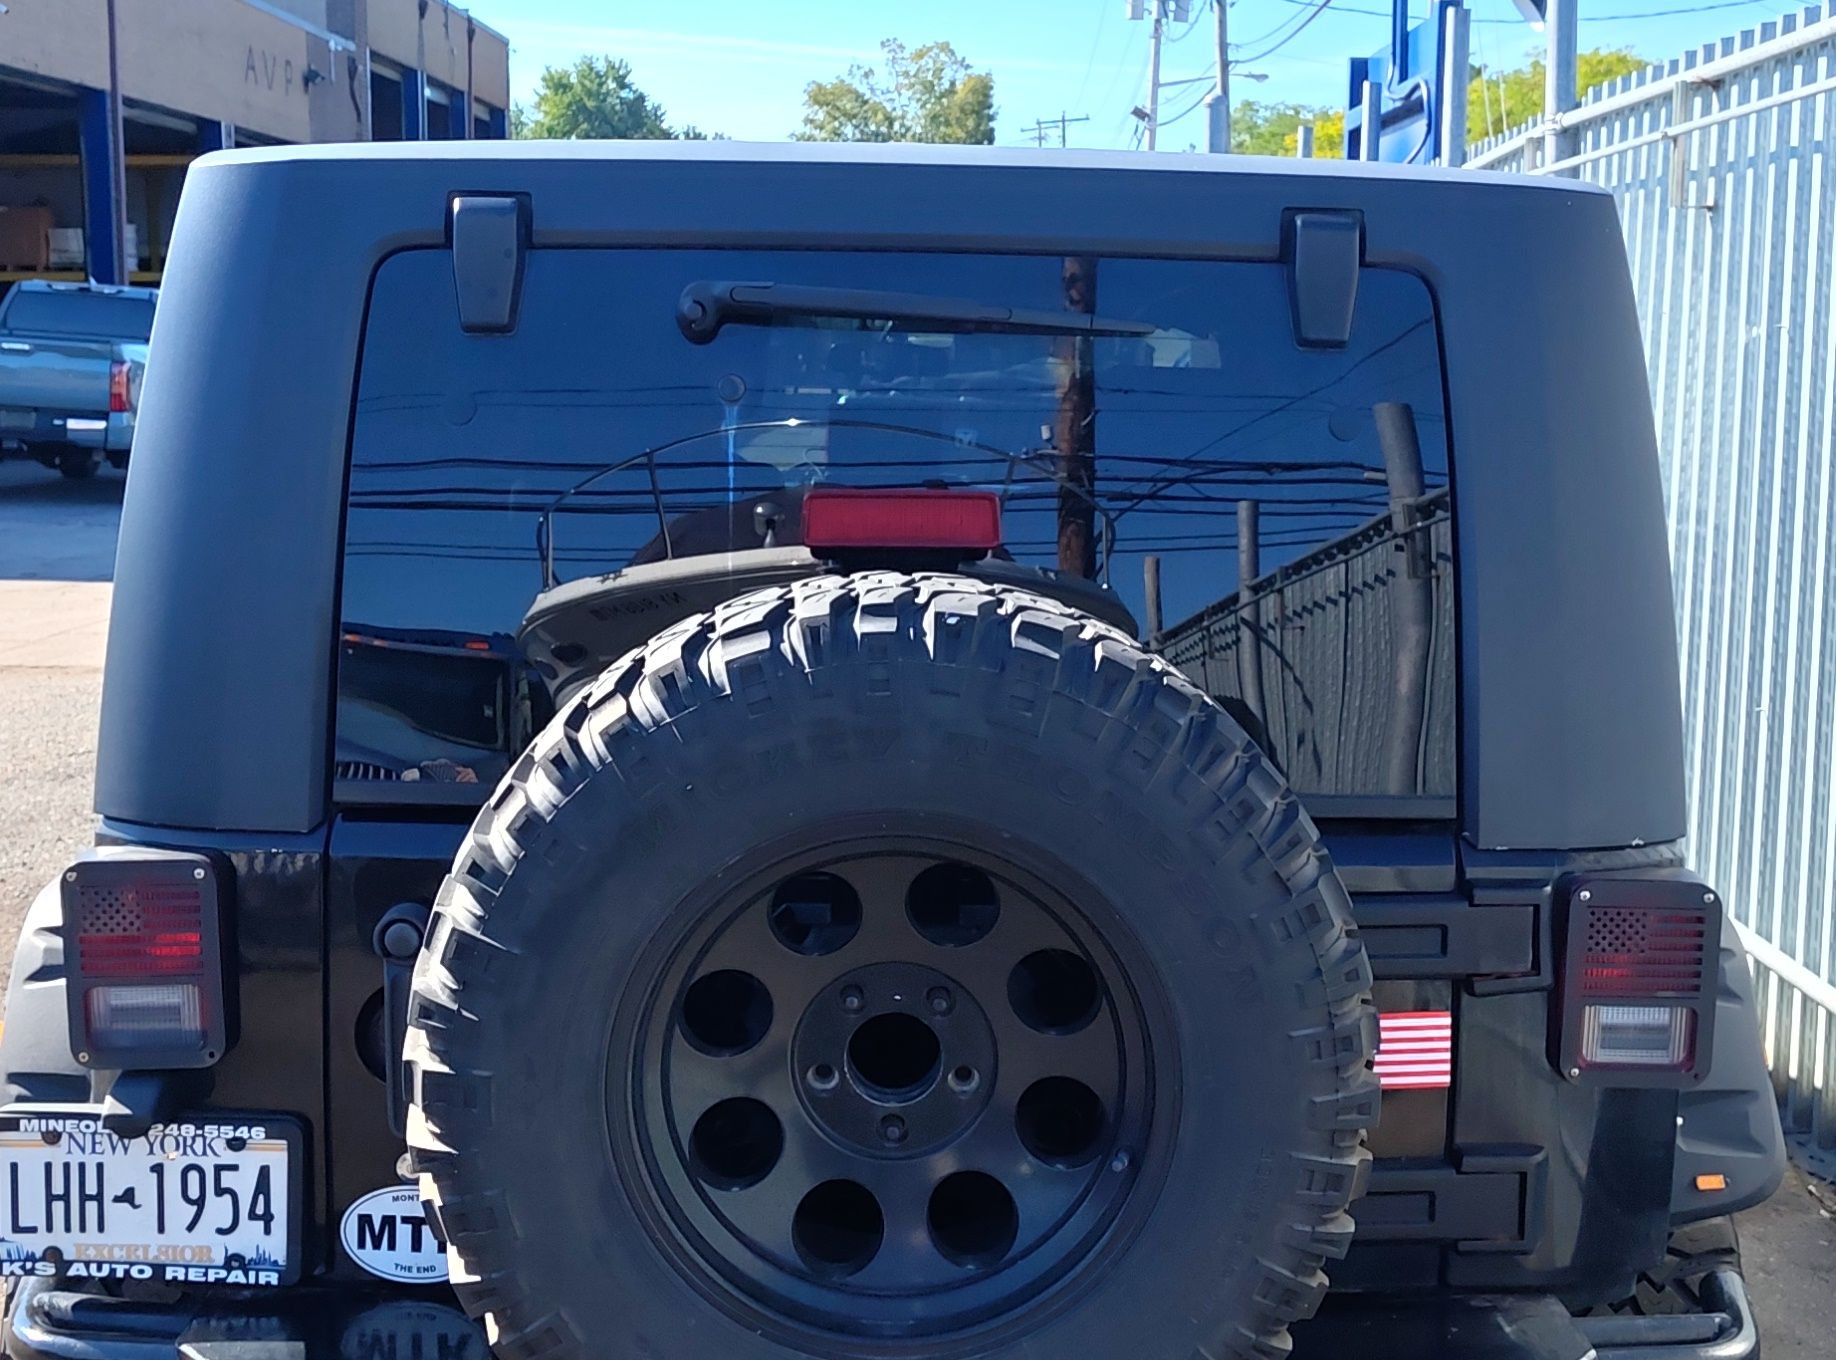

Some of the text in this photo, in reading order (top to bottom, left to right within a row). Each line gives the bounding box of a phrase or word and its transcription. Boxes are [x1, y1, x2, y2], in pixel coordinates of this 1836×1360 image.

[19, 1119, 266, 1140] MINEOL 248-5546
[65, 1131, 222, 1158] NEW YORK
[9, 1161, 275, 1236] LHH 1954
[392, 1194, 421, 1203] MONT
[357, 1213, 448, 1254] MT
[73, 1243, 215, 1264] EXCELSIOR
[66, 1262, 153, 1279] AUTO
[165, 1266, 279, 1286] REPAIR
[393, 1263, 437, 1274] THE END
